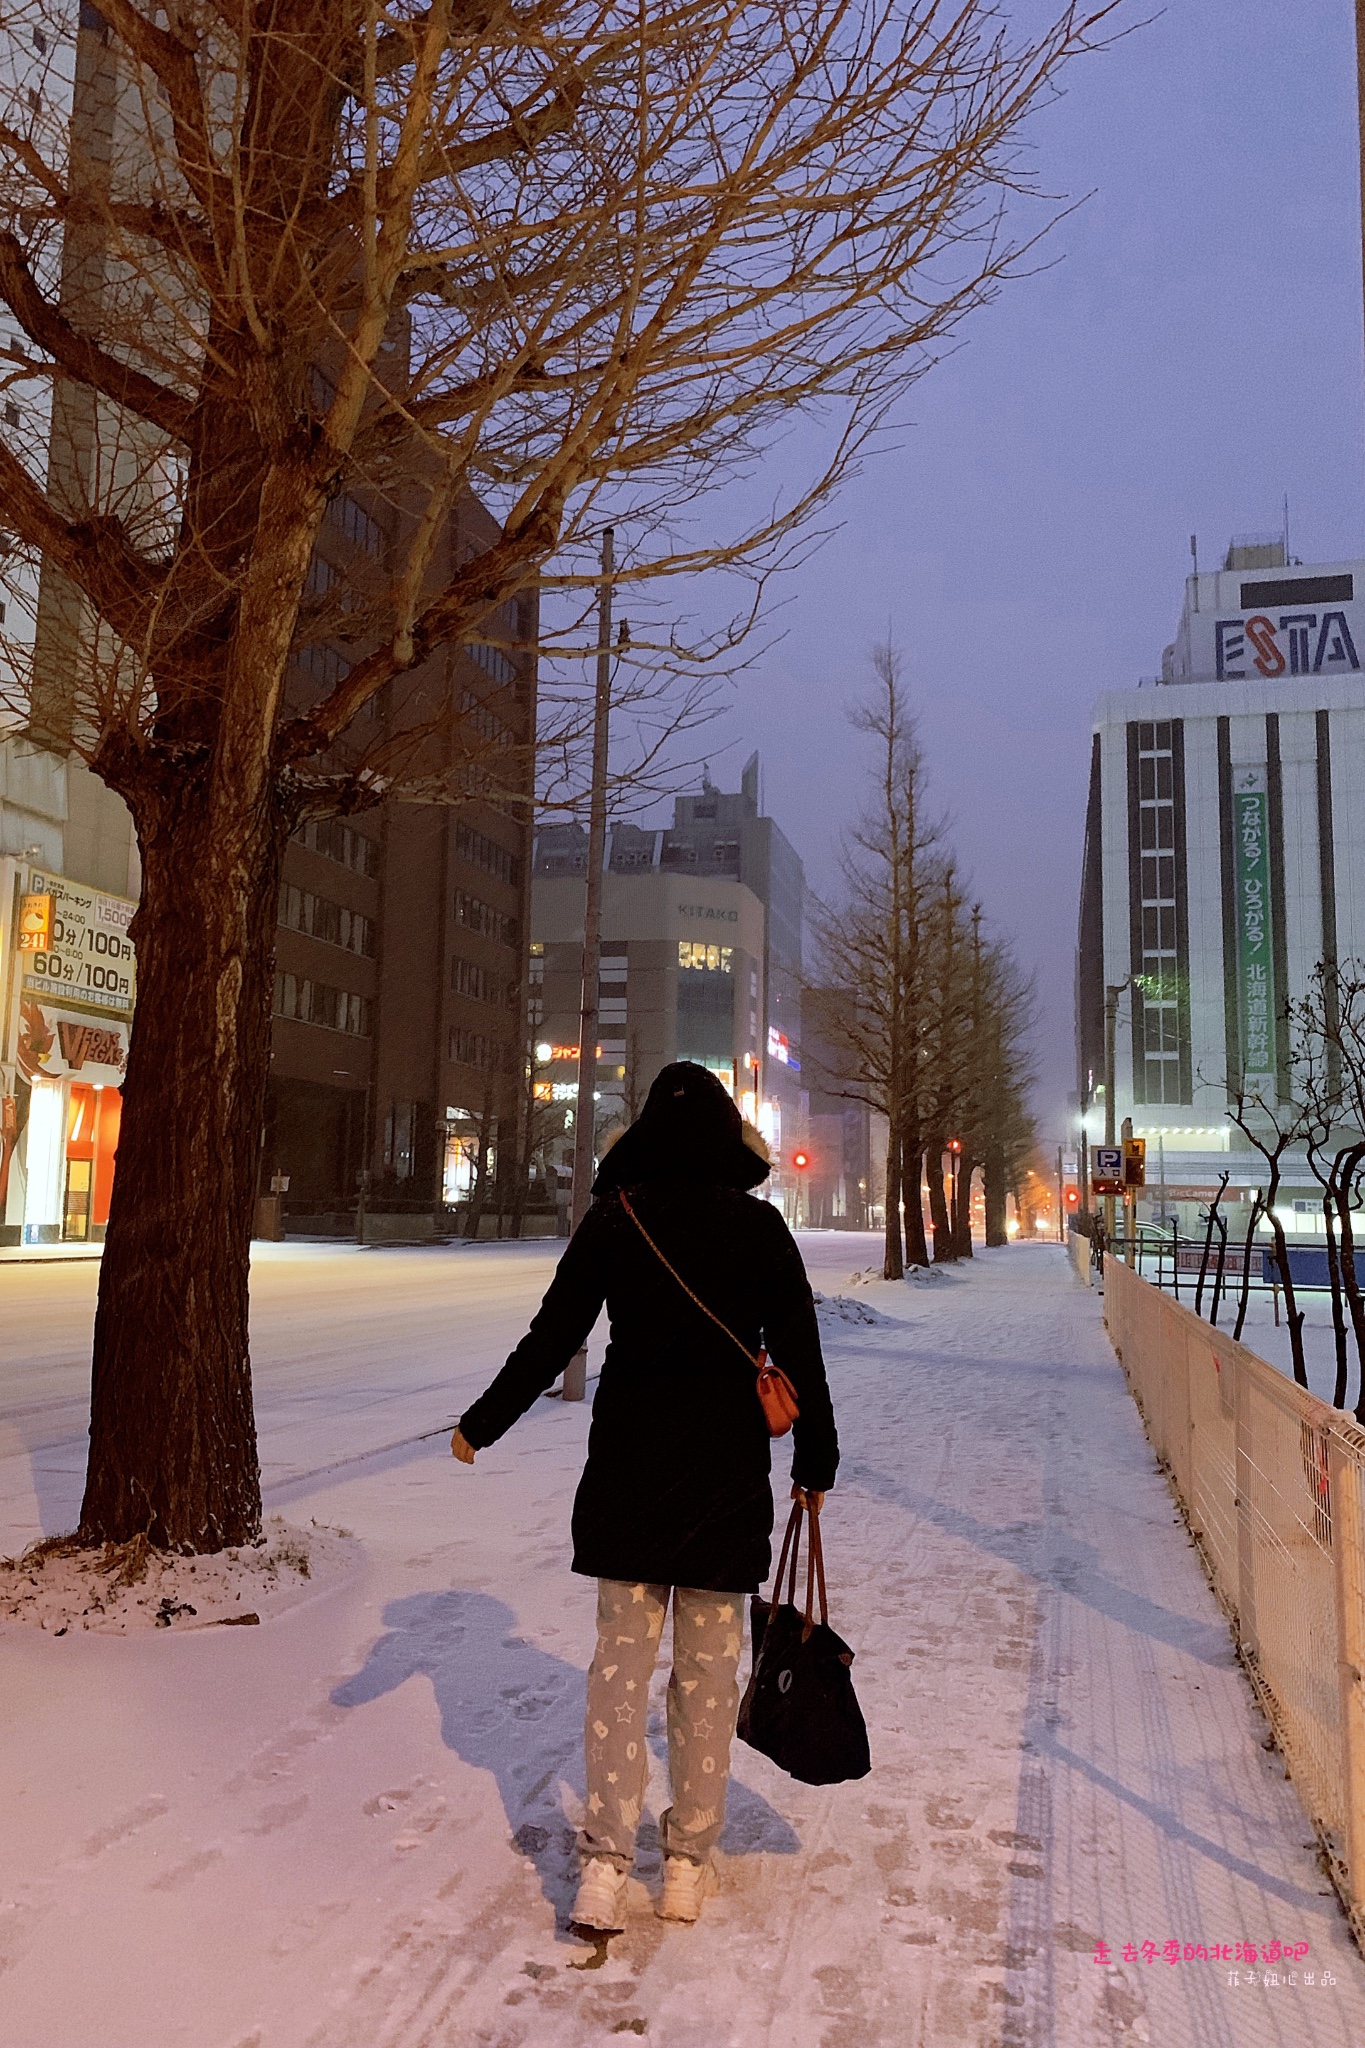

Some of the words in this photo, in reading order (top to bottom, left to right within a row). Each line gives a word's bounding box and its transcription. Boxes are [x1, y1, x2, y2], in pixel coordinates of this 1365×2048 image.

[1215, 611, 1360, 681] ESTA
[1242, 797, 1262, 871] つながる！
[678, 905, 738, 922] KITAKO
[1244, 879, 1264, 955] ひろがる！
[33, 952, 129, 994] 60分/100円
[1246, 963, 1269, 1067] 北海道新幹線
[1169, 1189, 1223, 1198] BicCamer
